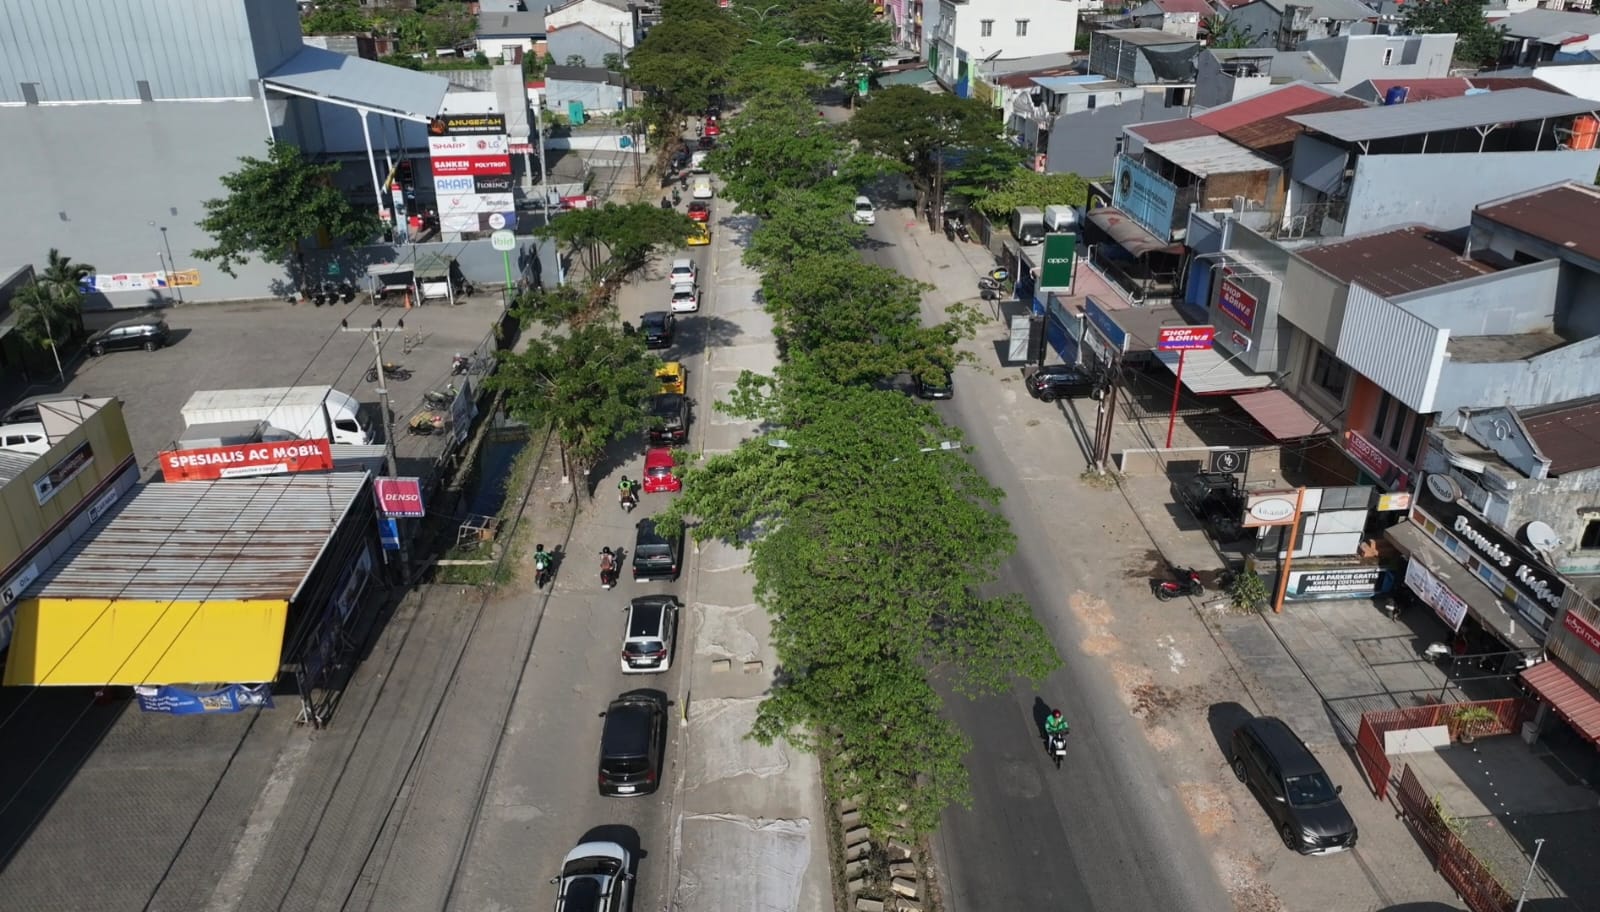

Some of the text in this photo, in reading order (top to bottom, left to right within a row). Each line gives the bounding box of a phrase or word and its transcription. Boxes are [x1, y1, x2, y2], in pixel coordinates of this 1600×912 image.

[433, 142, 466, 150] SHARP
[488, 140, 500, 149] LG
[434, 160, 470, 169] SANKEN
[437, 178, 473, 189] AKARI
[1221, 282, 1241, 299] SHOP
[170, 444, 323, 468] SPESIALIS AC MOBIL
[385, 493, 419, 501] DENSO
[1454, 515, 1512, 567] Brownies
[1515, 564, 1561, 608] Kukus
